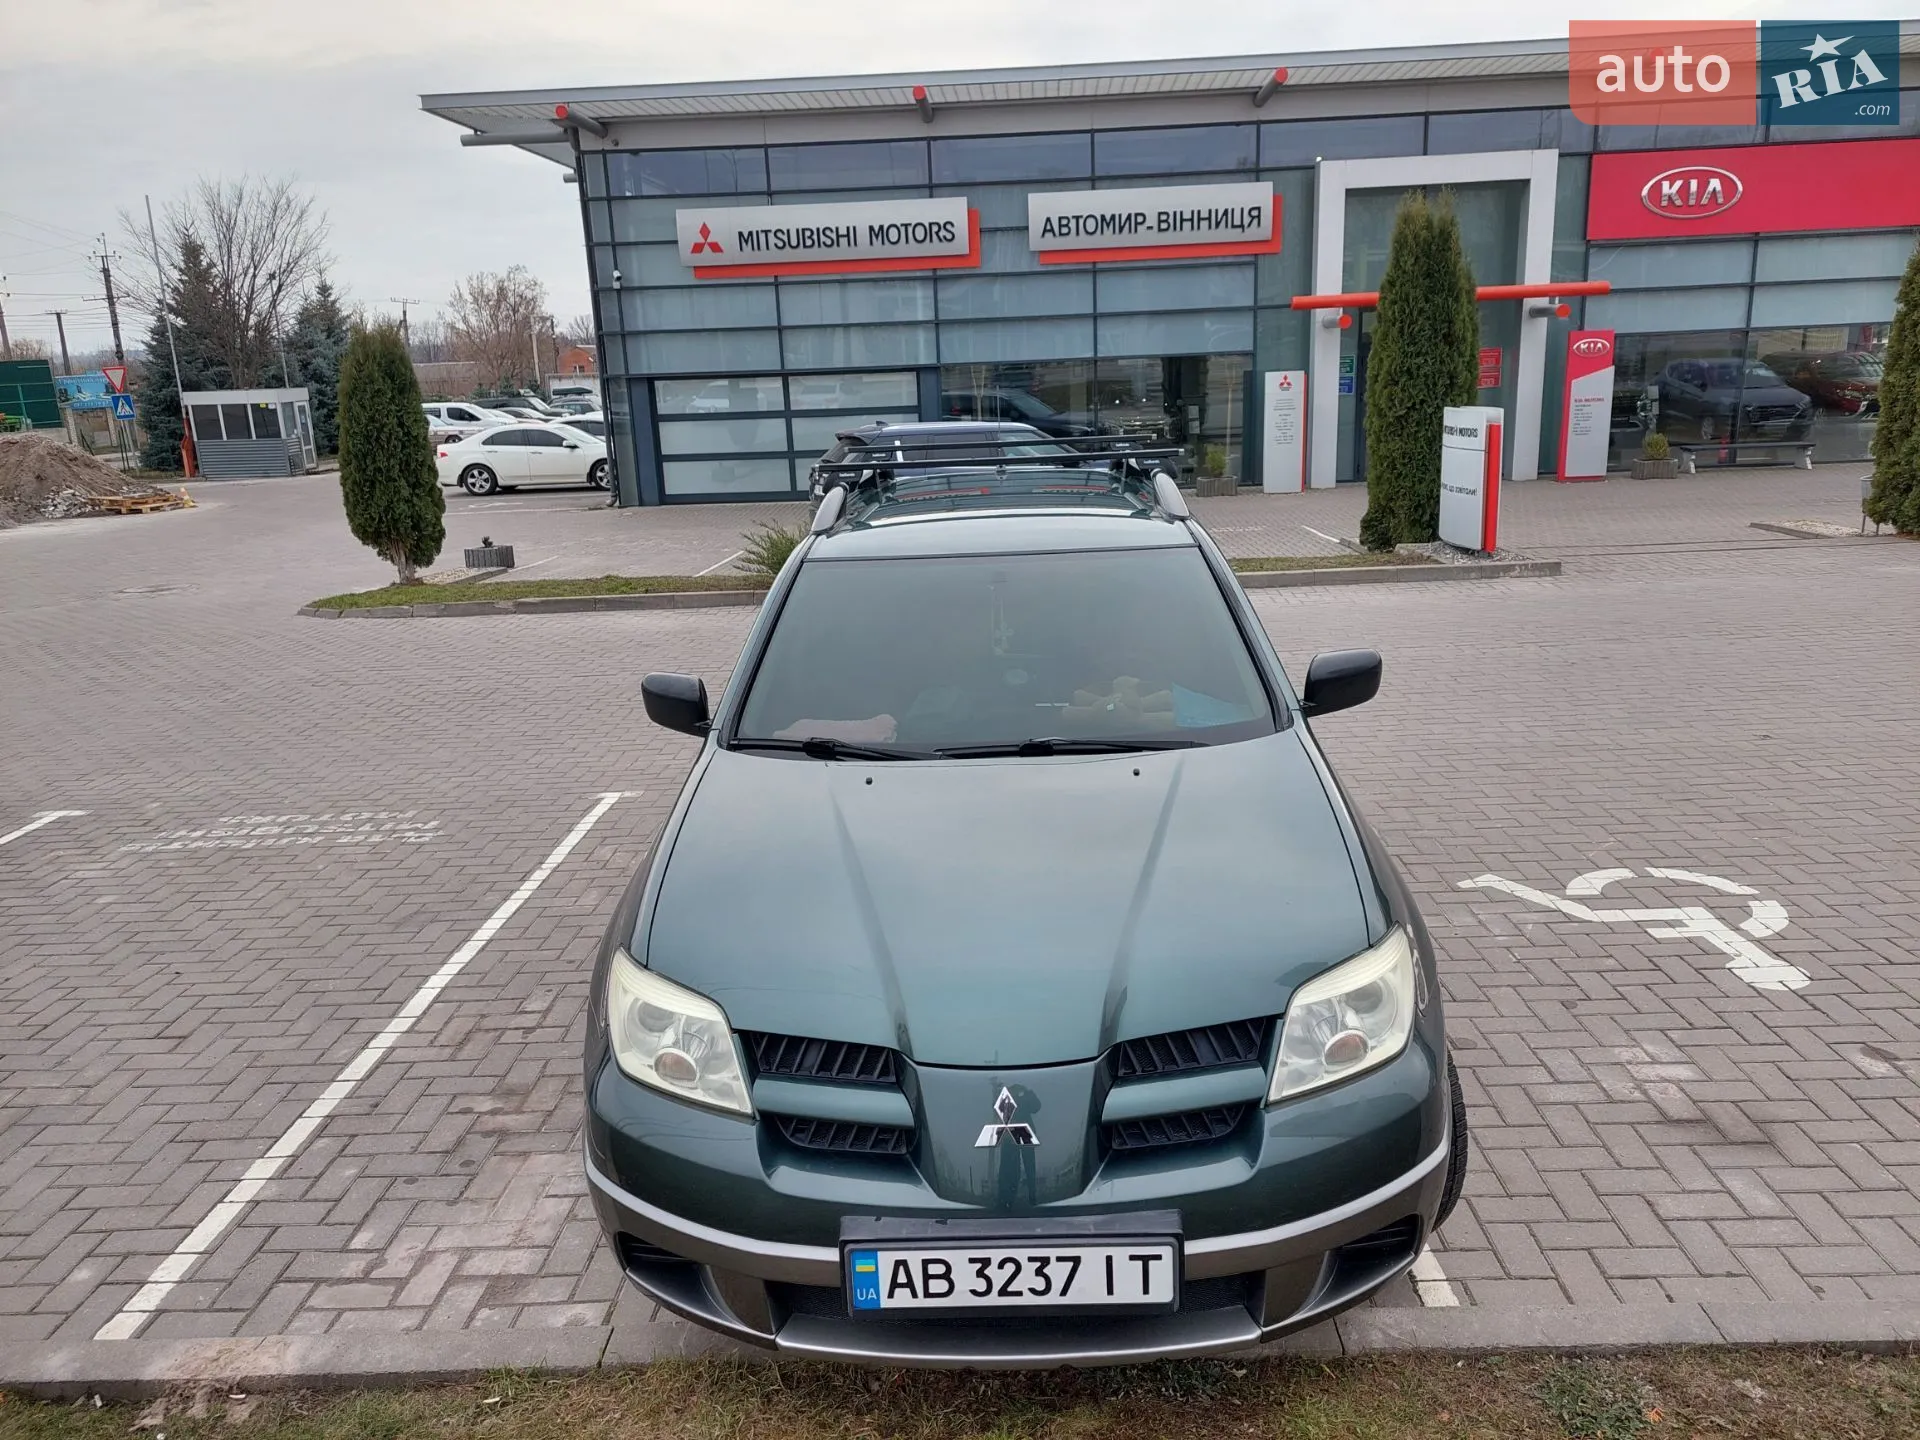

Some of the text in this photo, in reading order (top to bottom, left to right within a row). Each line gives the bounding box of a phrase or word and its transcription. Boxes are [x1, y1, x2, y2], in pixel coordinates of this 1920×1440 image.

[1660, 178, 1724, 207] KIA
[737, 221, 956, 252] MITSUBISHI MOTORS
[1041, 206, 1262, 239] АВТОМИР-ВІННИЦЯ
[1580, 342, 1604, 353] KIA
[887, 1254, 1163, 1299] AB 3237 IT
[857, 1288, 877, 1301] UA
